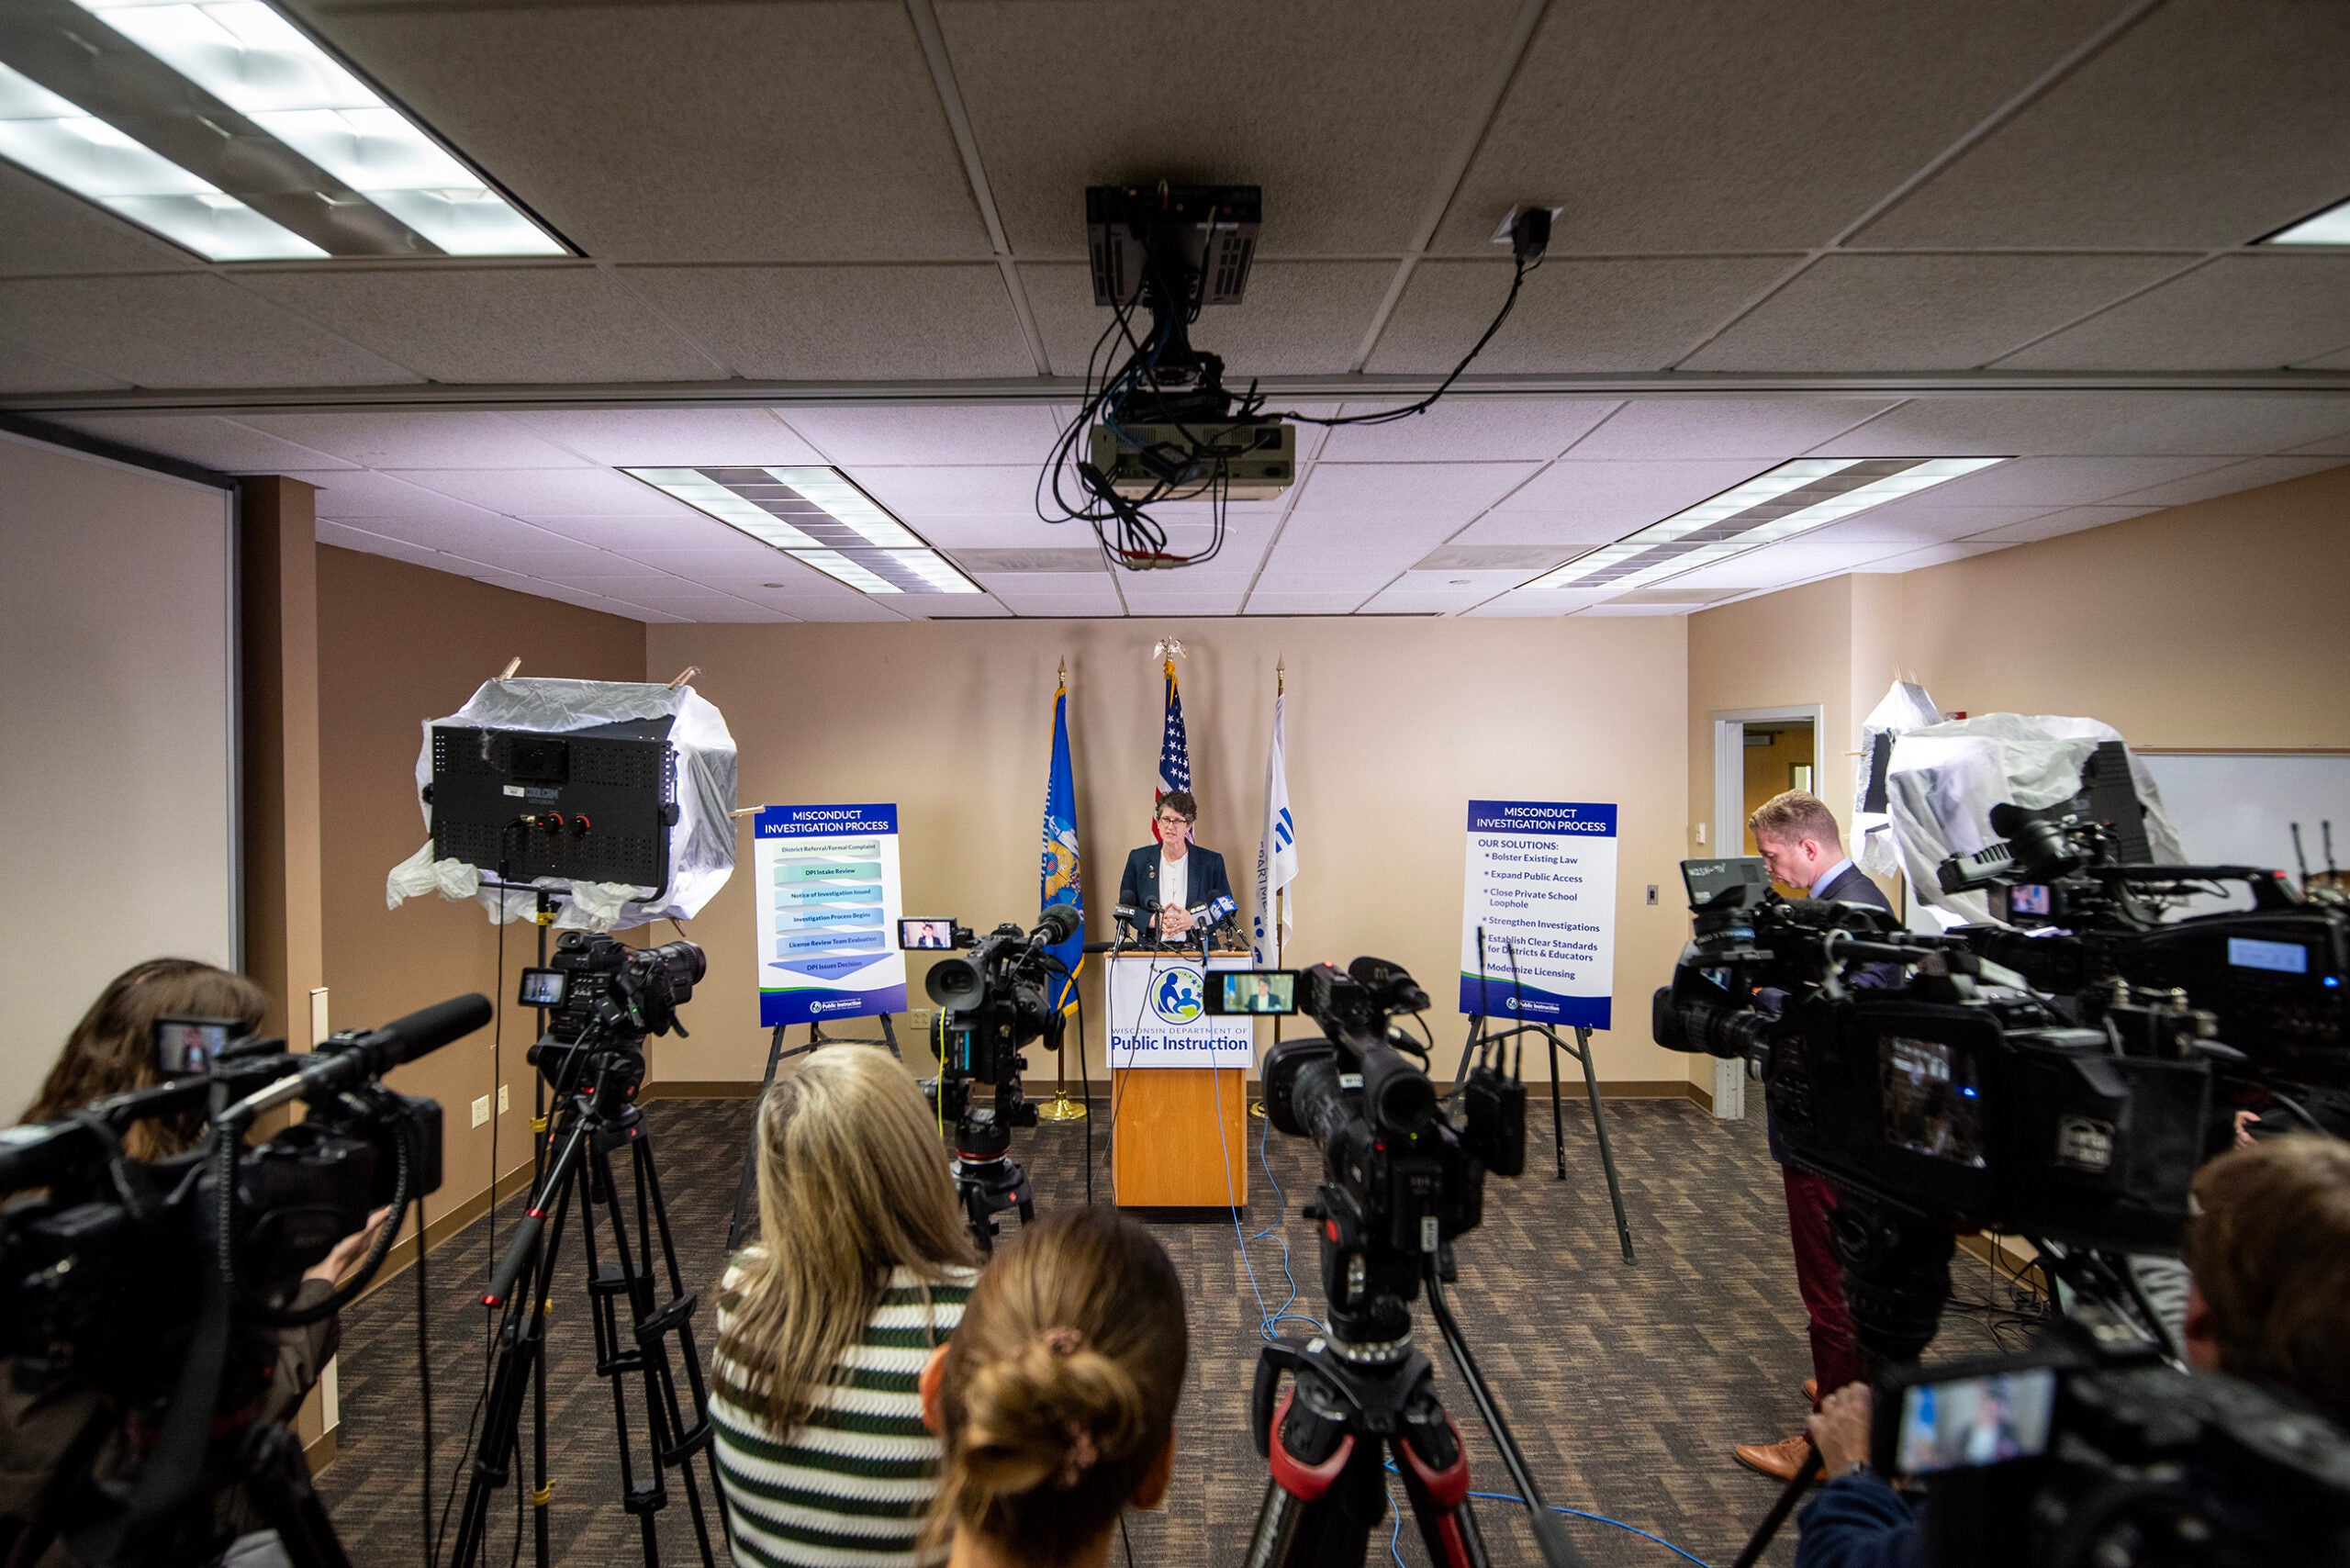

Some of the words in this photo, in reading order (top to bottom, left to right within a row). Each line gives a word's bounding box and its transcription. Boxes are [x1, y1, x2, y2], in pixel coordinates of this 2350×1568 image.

[792, 810, 862, 821] MISCONDUCT
[1504, 807, 1577, 818] MISCONDUCT
[765, 823, 844, 834] INVESTIGATION
[845, 821, 889, 831] PROCESS
[1476, 818, 1556, 830] INVESTIGATION
[1557, 821, 1606, 832] PROCESS
[804, 844, 847, 852] Referral/Formal
[848, 843, 876, 851] Complaint
[1478, 839, 1499, 847] OUR
[1501, 839, 1559, 850] SOLUTIONS:
[1492, 853, 1522, 861] Bolster
[1524, 854, 1559, 865] Existing
[1491, 870, 1522, 879] Expand
[1524, 872, 1550, 881] Public
[1552, 874, 1583, 883] Access
[818, 890, 854, 898] Investigation
[1490, 888, 1513, 897] Close
[1515, 890, 1547, 900] Private
[1548, 891, 1577, 902] School
[1490, 899, 1528, 908] Loophole
[793, 913, 830, 923] Investigation
[1489, 916, 1536, 927] Strengthen
[1538, 920, 1600, 932] Investigations
[848, 935, 877, 944] Evaluation
[1488, 934, 1526, 945] Establish
[1528, 937, 1551, 946] Clear
[1552, 939, 1598, 951] Standards
[1487, 945, 1500, 953] for
[1502, 946, 1538, 957] Dstricts
[1539, 949, 1548, 958] &
[1549, 950, 1594, 962] Educators
[837, 960, 862, 969] Decision
[1487, 962, 1533, 974] Modernize
[1534, 967, 1575, 980] Licensing
[1112, 1036, 1158, 1050] Public
[1163, 1036, 1248, 1050] Instruction
